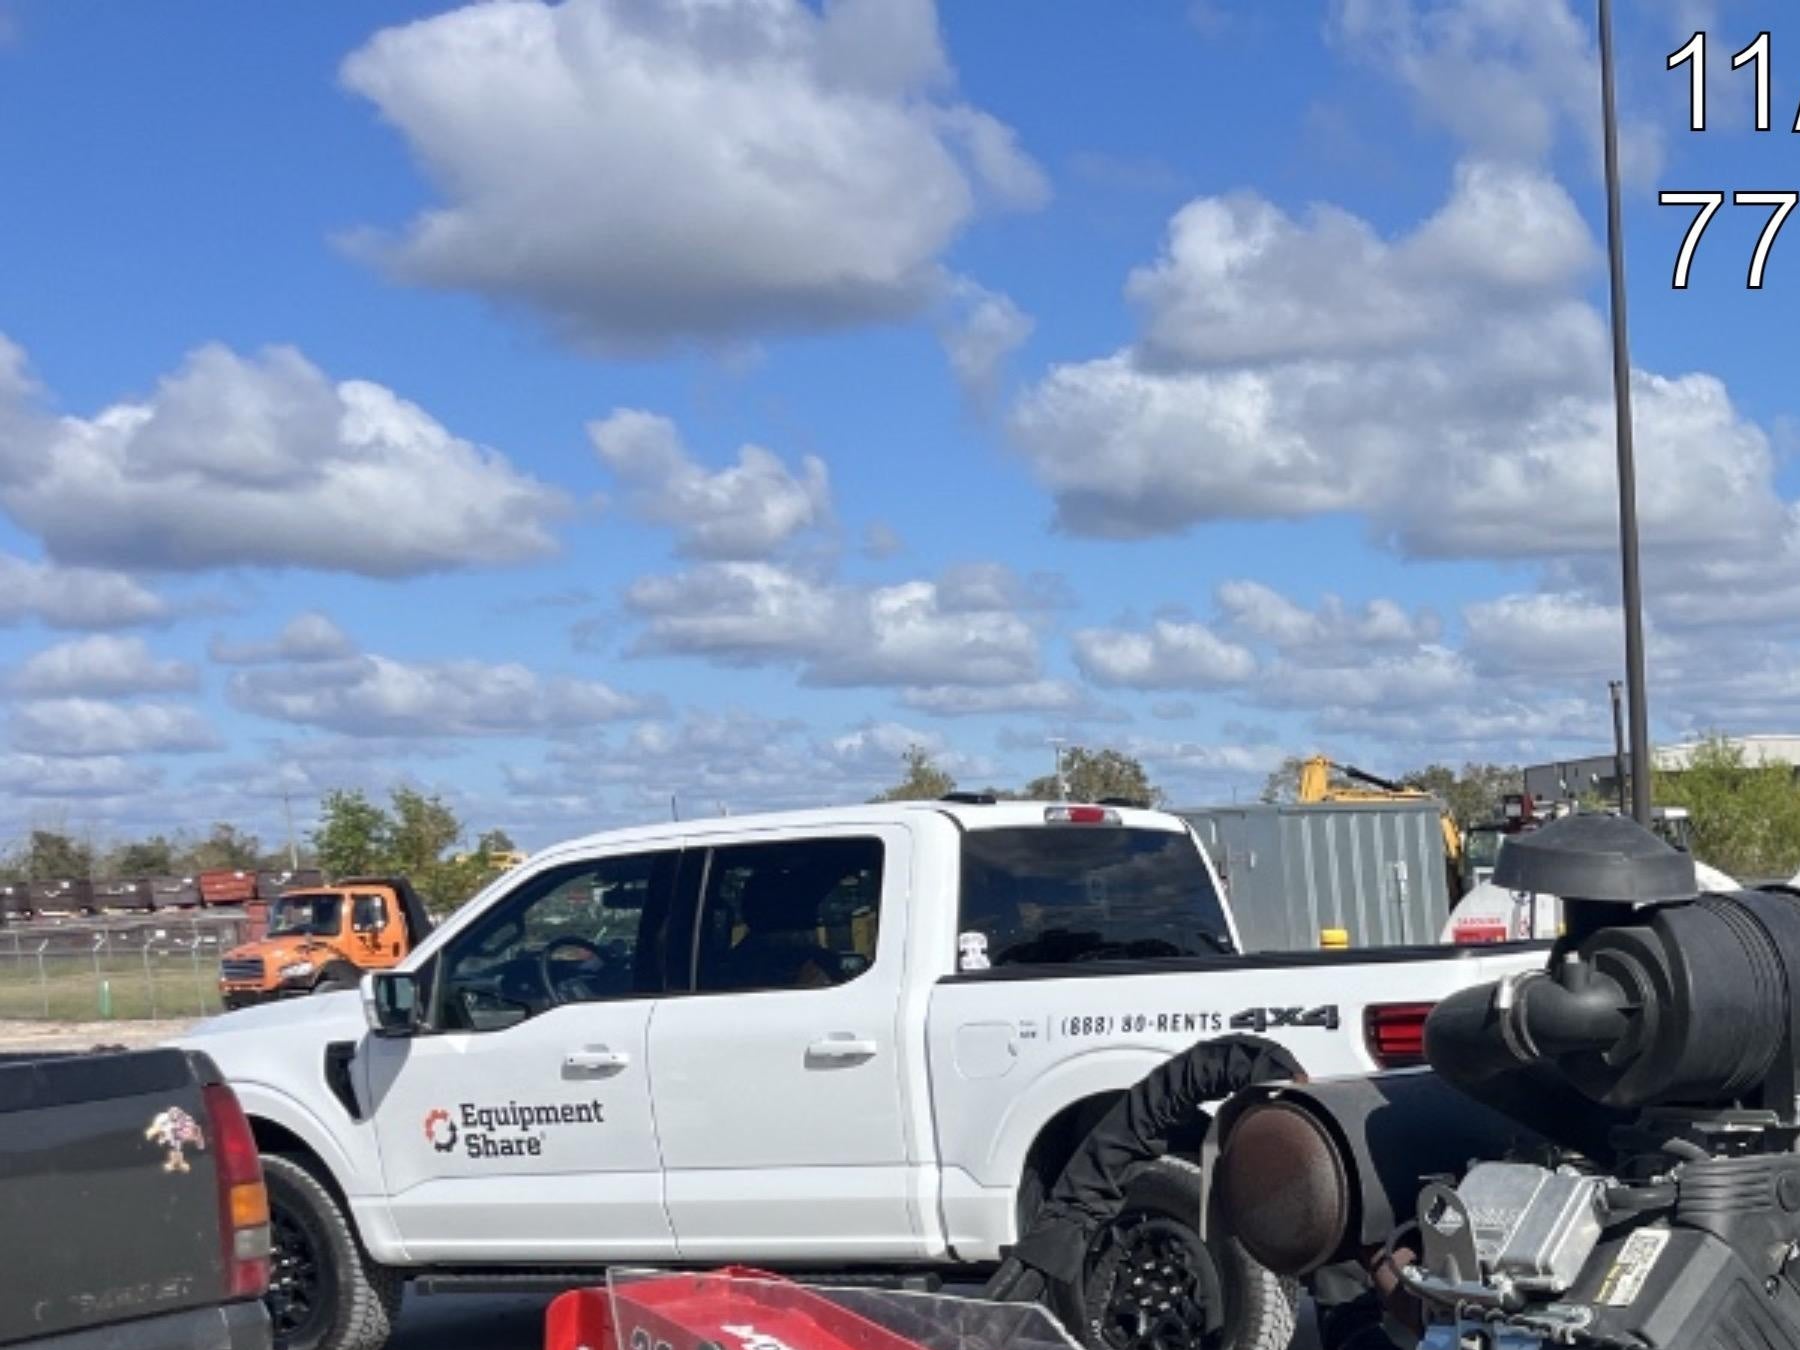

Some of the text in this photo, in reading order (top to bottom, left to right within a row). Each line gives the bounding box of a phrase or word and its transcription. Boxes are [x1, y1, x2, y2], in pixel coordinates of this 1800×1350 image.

[1061, 1016, 1114, 1037] (888)
[1121, 1012, 1222, 1034] 80-RENTS
[459, 1098, 605, 1133] Equipment
[464, 1133, 542, 1159] Share
